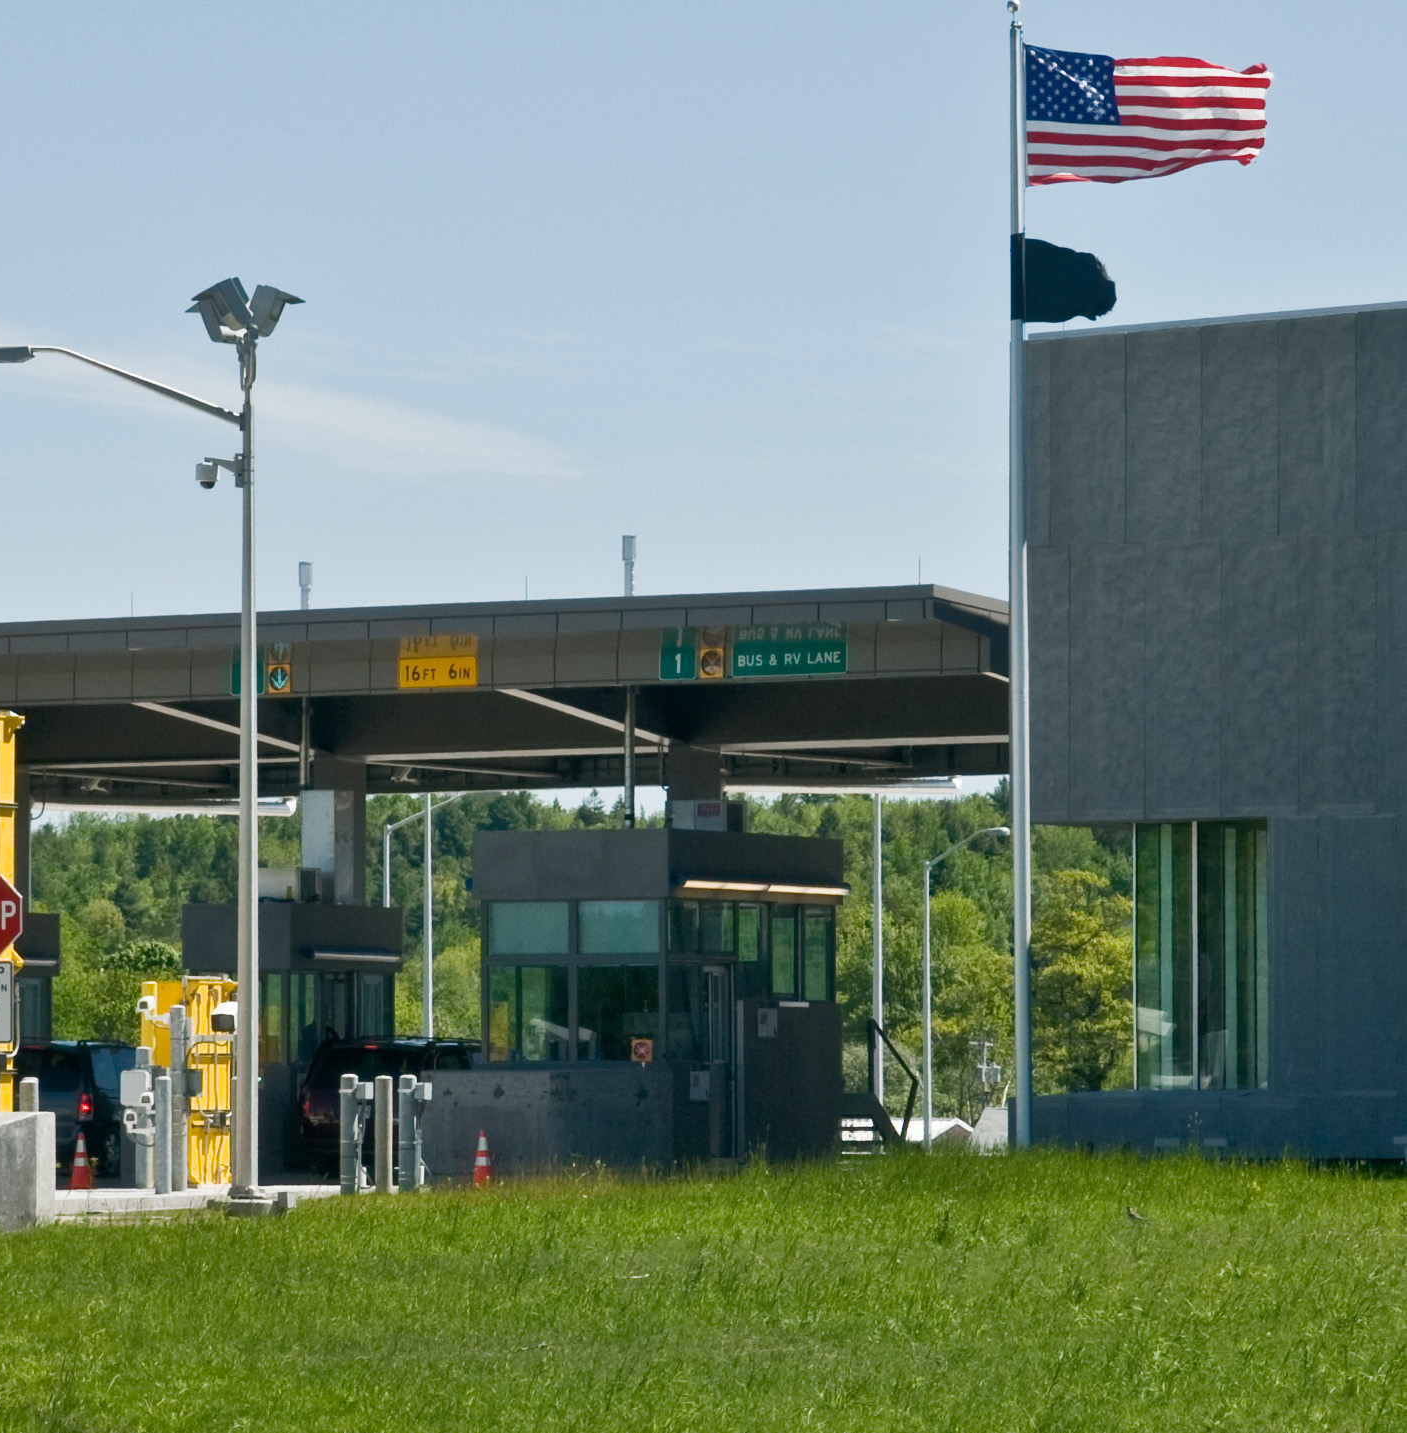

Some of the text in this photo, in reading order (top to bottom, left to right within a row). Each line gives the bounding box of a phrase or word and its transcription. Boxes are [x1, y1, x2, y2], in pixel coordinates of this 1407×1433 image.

[674, 653, 682, 674] 1
[737, 651, 841, 667] BUS & RV LANE
[448, 663, 470, 680] 6IN
